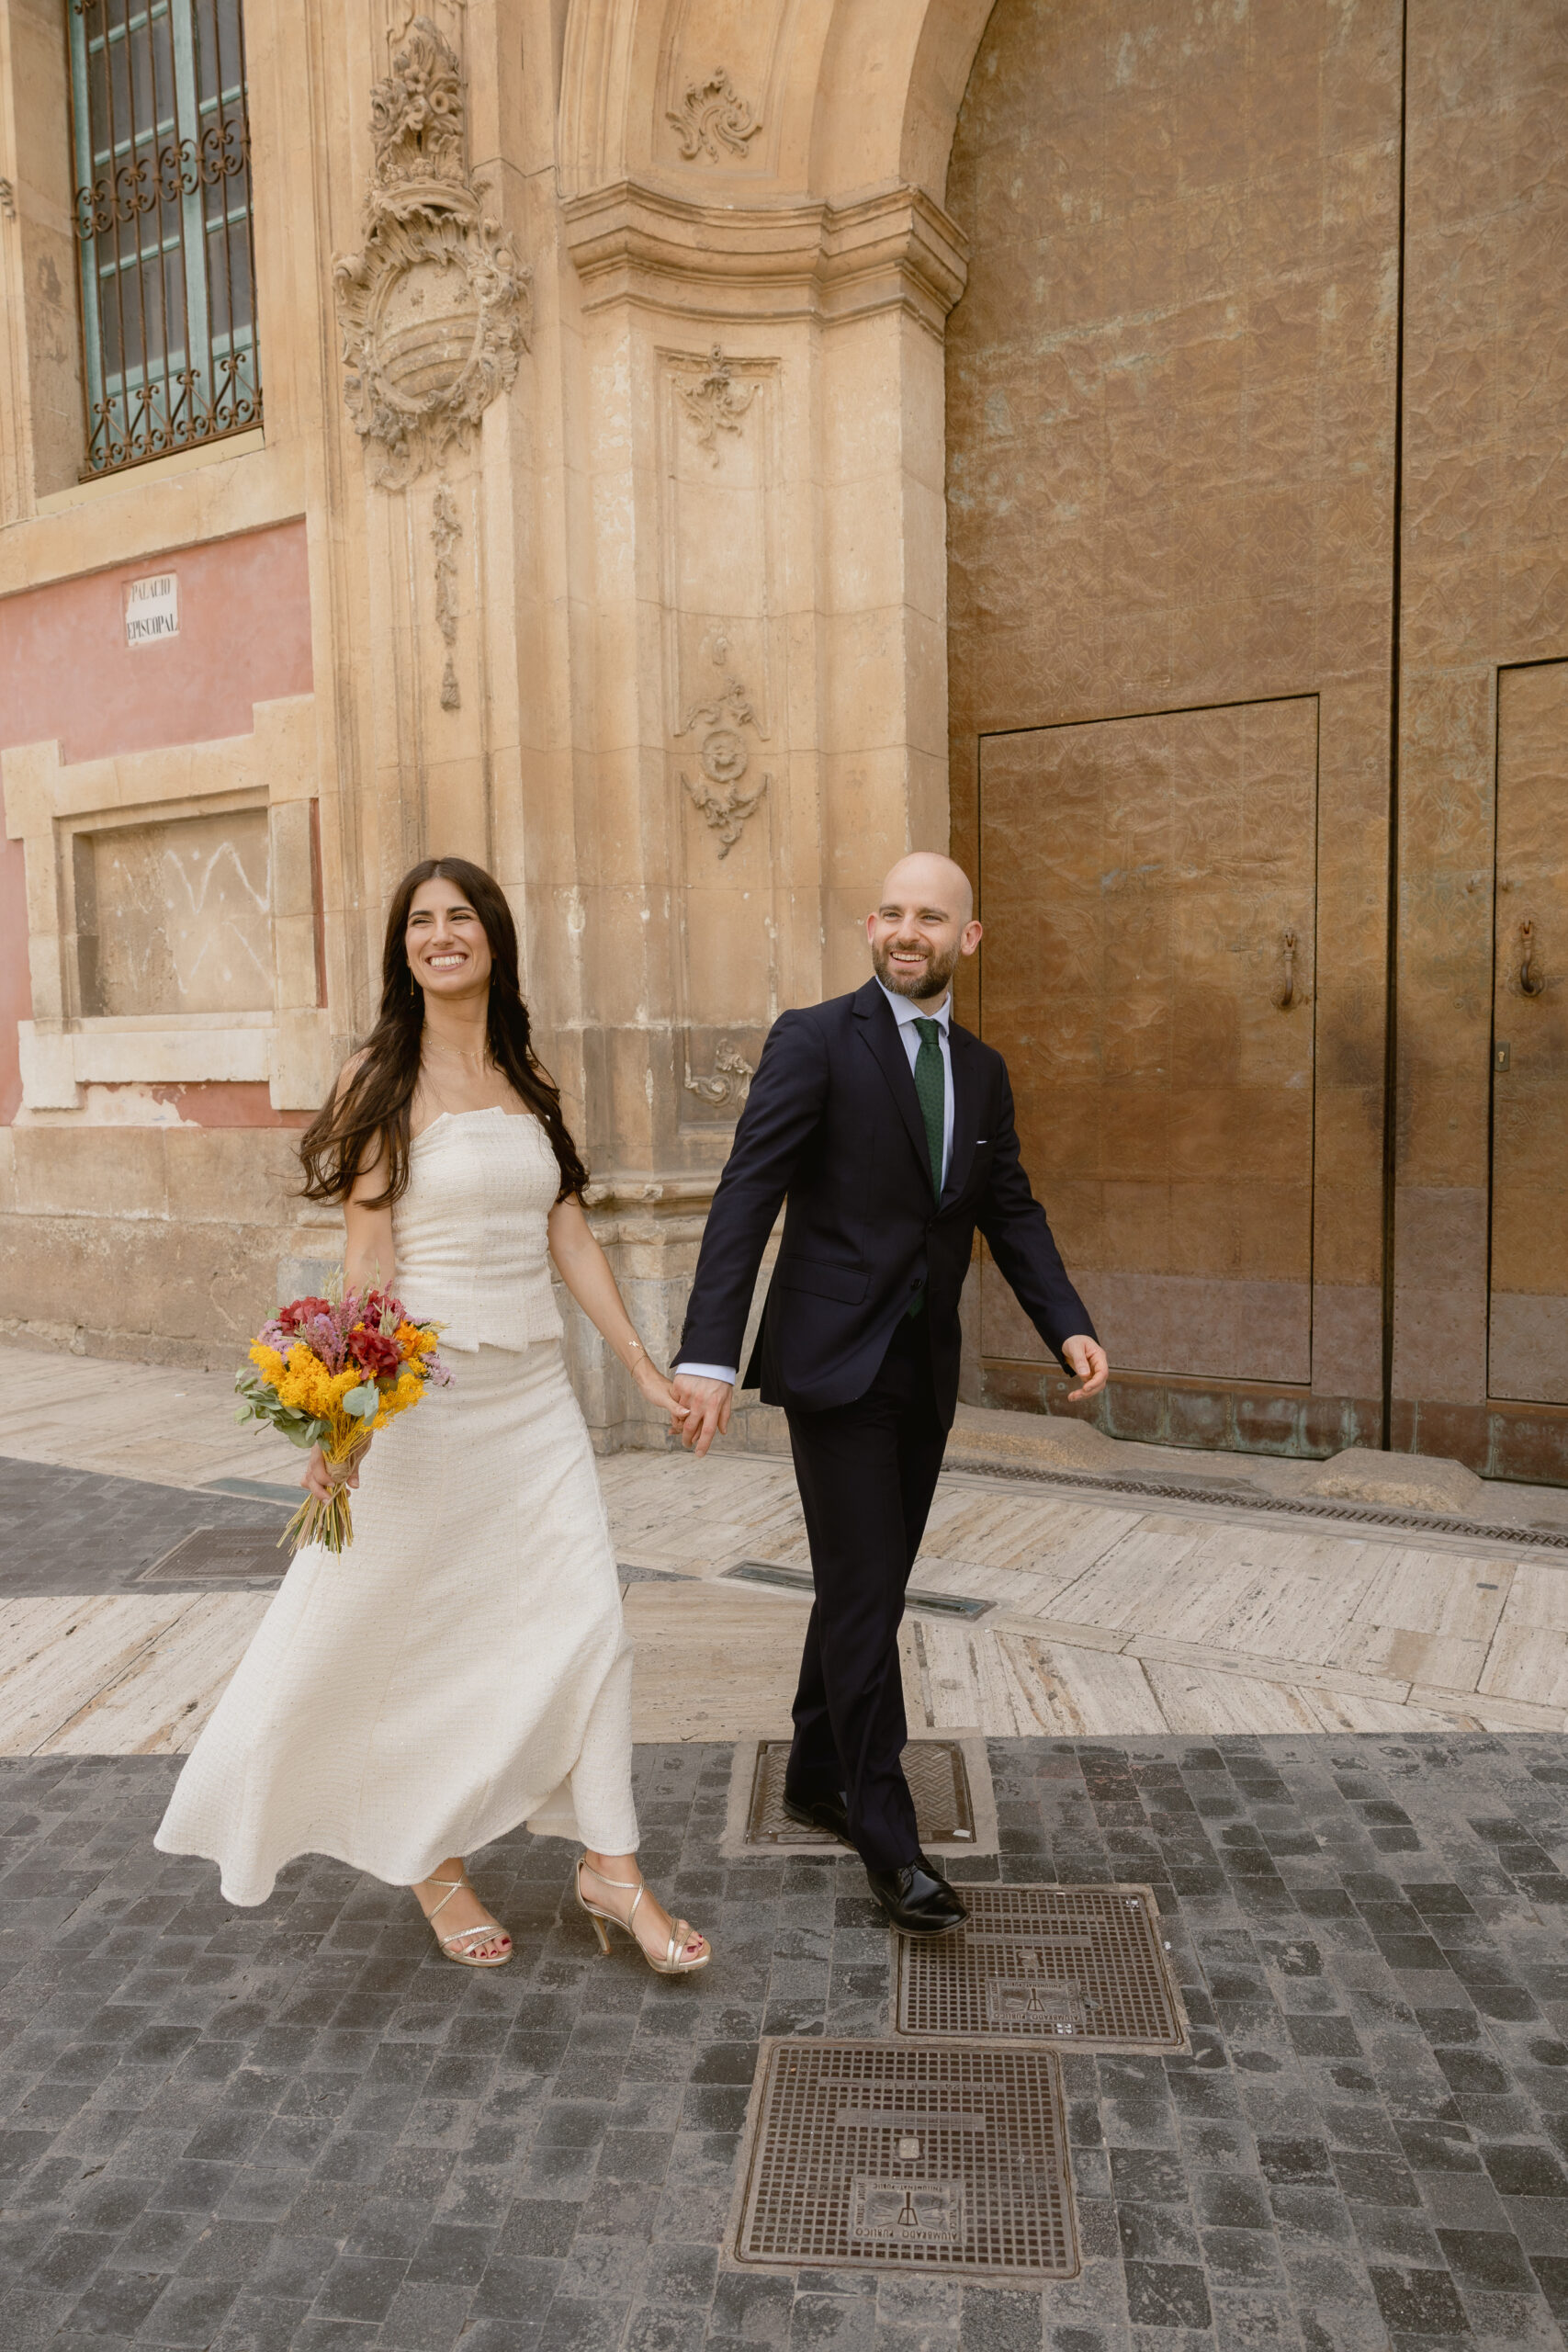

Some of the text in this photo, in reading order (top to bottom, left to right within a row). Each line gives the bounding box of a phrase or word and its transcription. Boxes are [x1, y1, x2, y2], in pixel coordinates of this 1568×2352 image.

[131, 578, 171, 603] PALACIO
[127, 613, 177, 639] EPISCOPAL
[902, 2230, 958, 2241] ALUMBRADO
